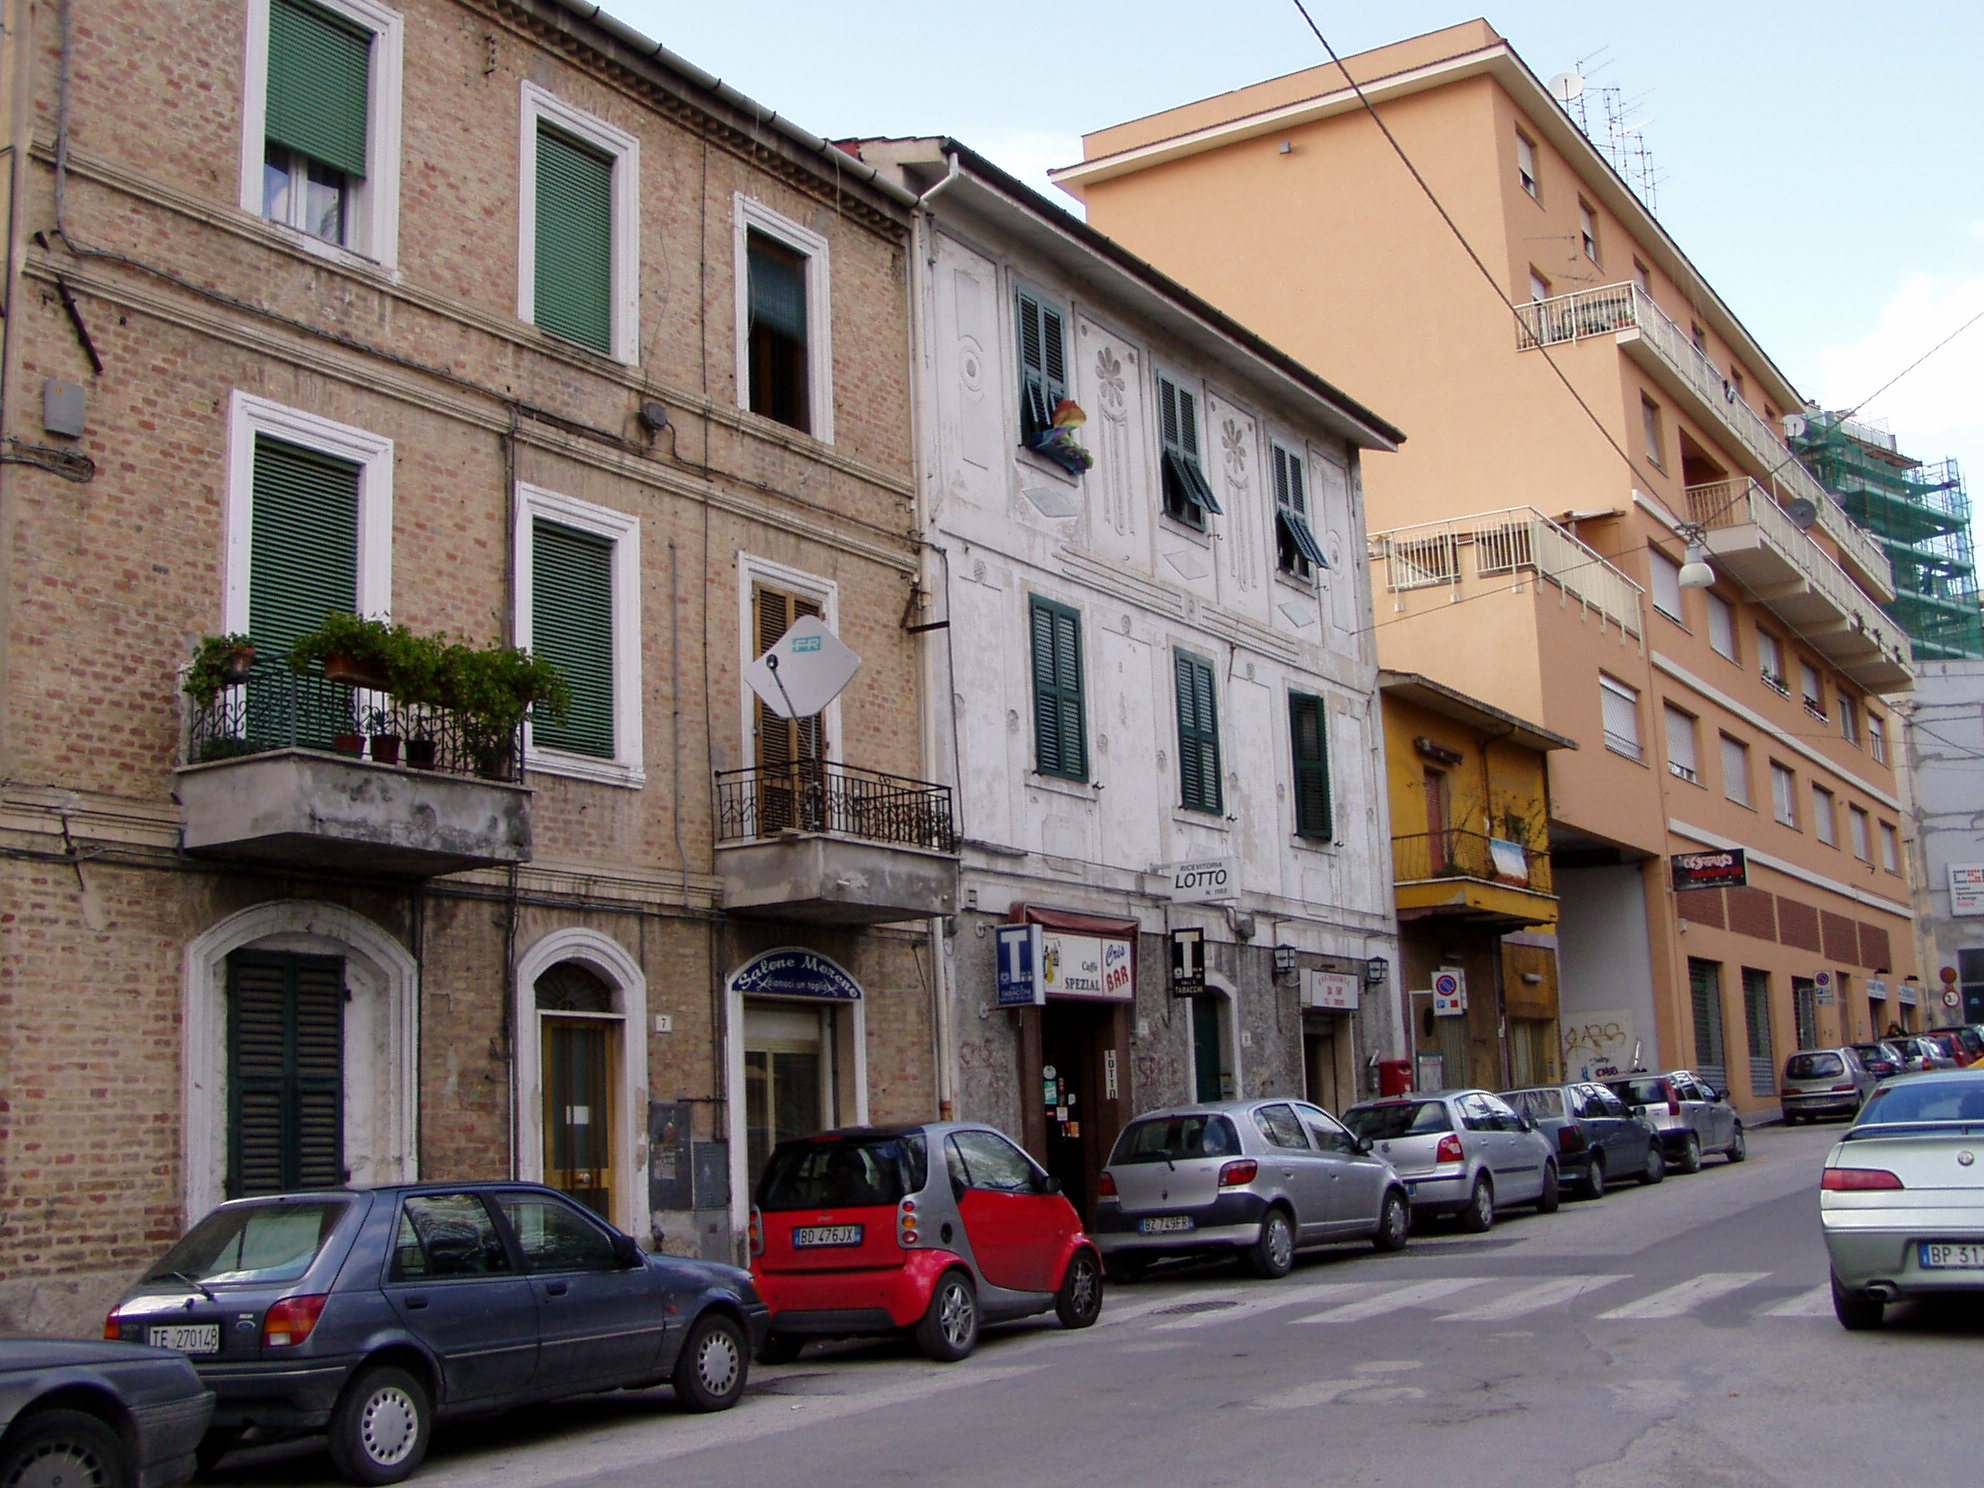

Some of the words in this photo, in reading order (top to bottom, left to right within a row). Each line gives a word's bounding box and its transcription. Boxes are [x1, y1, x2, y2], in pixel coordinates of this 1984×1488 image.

[1175, 869, 1227, 889] LOTTO
[1000, 929, 1028, 983] T
[1175, 931, 1200, 978] T
[738, 959, 796, 990] Salone
[800, 955, 858, 998] Moreno
[1064, 977, 1100, 991] SPEZIAL
[1106, 964, 1129, 992] BAR
[661, 1017, 667, 1029] 7
[801, 1230, 815, 1244] BD
[818, 1227, 853, 1242] 476JX
[1931, 1246, 1951, 1263] BP
[1957, 1246, 1984, 1264] 31
[152, 1329, 169, 1349] TE
[176, 1327, 218, 1349] 270148
